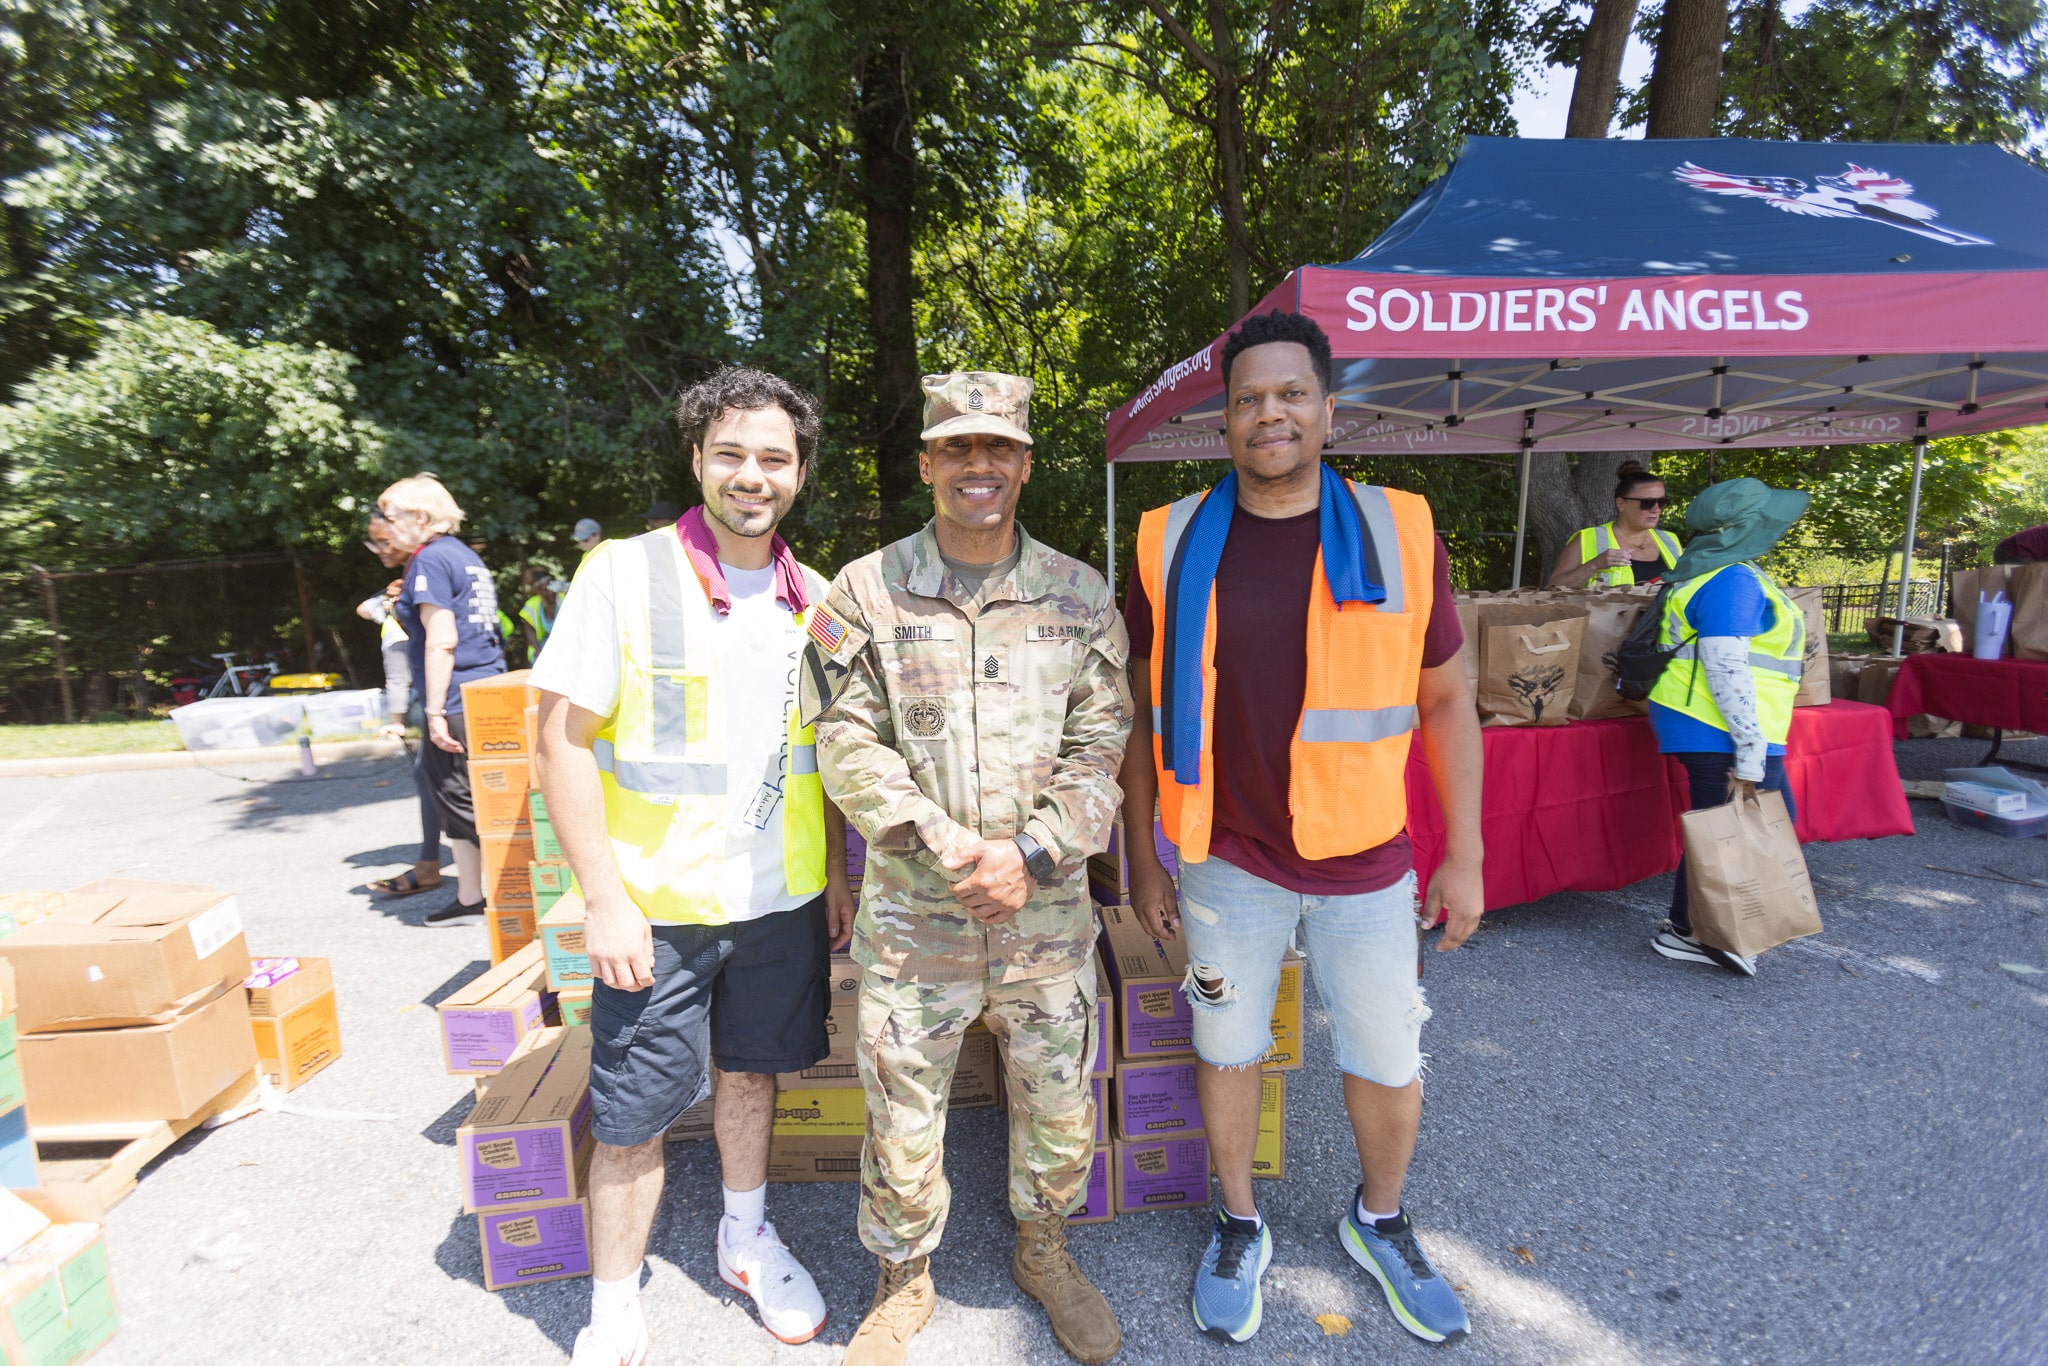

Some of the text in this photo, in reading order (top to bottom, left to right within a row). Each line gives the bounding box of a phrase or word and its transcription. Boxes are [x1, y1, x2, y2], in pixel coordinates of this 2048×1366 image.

[1346, 285, 1809, 332] SOLDIERS' ANGELS
[894, 625, 932, 640] SMITH
[1150, 1037, 1192, 1047] samoas
[1145, 1119, 1185, 1130] samoas
[495, 1188, 542, 1200] samoas
[1143, 1191, 1186, 1204] samoas
[517, 1263, 563, 1277] samoas
